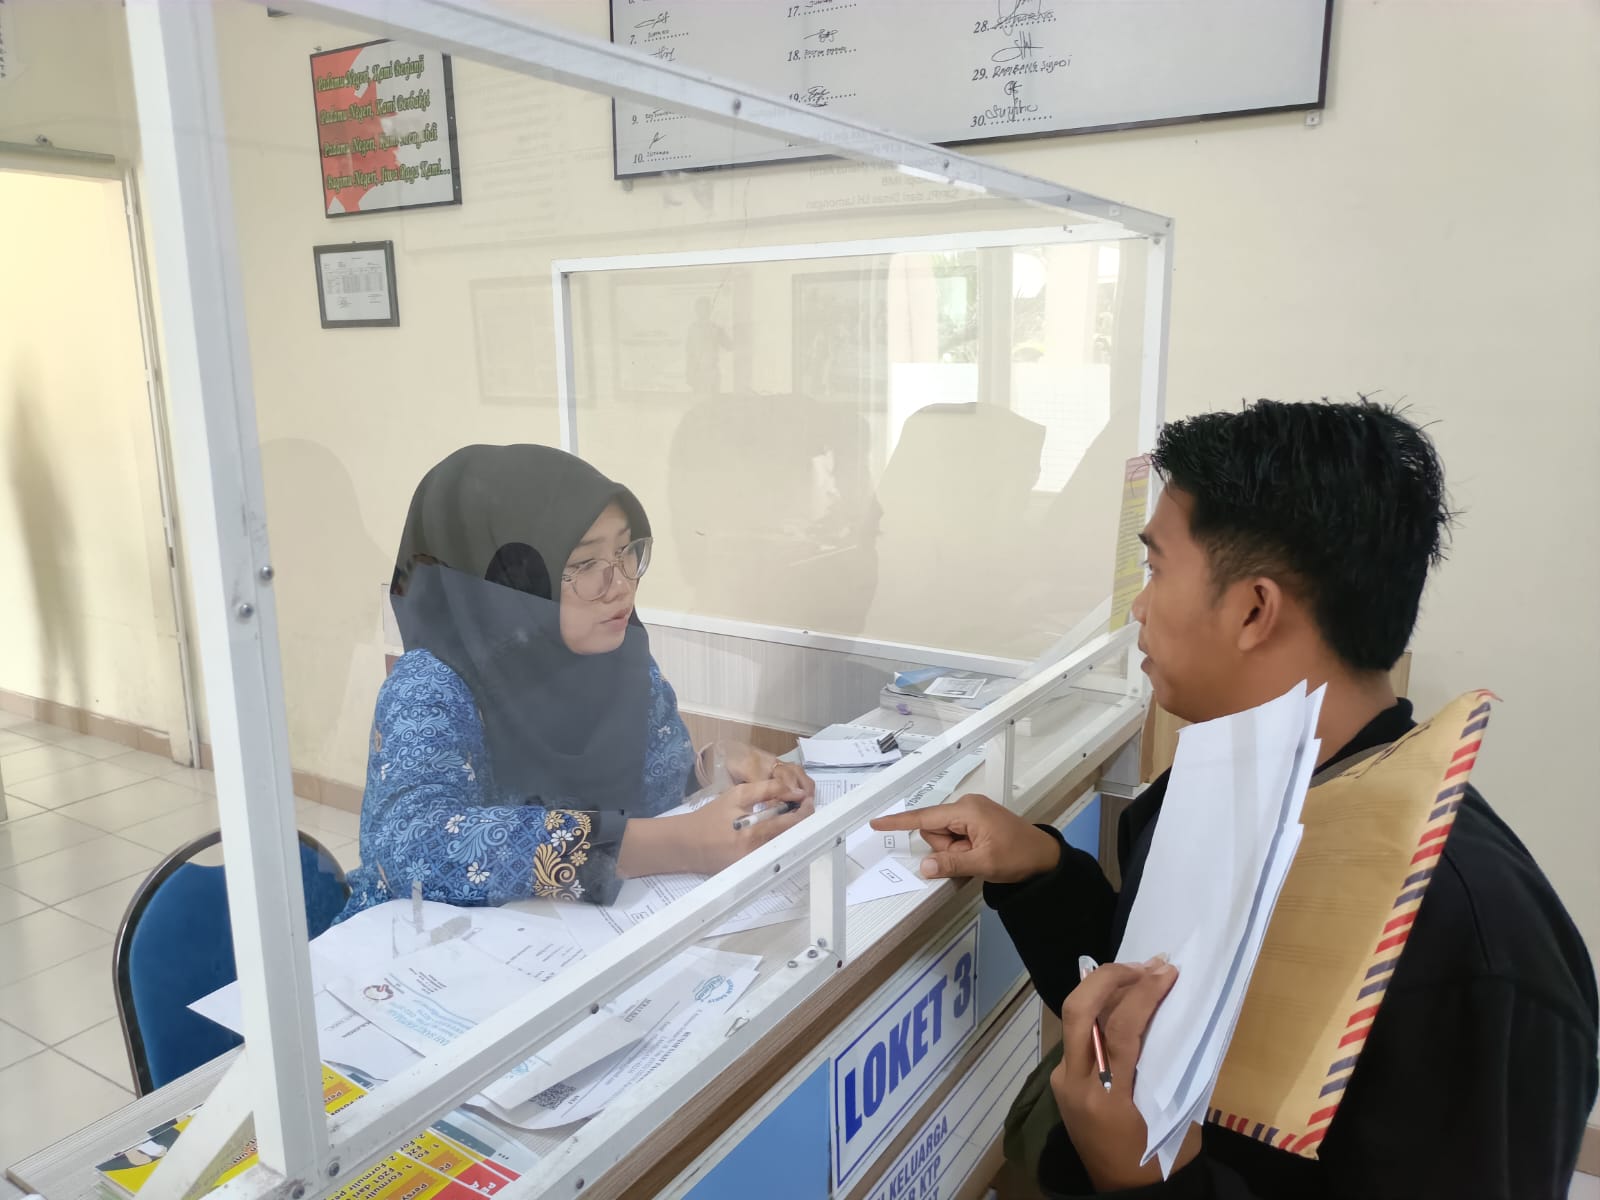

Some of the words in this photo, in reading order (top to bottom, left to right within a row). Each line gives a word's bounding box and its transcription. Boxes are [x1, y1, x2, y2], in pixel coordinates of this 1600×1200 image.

[788, 6, 800, 17] 17.
[973, 20, 990, 34] 28.
[630, 34, 637, 45] 7.
[787, 49, 801, 62] 18.
[972, 68, 988, 81] 29.
[970, 115, 987, 127] 30.
[632, 153, 645, 164] 10.
[844, 974, 948, 1144] LOKET
[953, 951, 972, 1019] 3
[889, 1115, 948, 1199] KELUARGA
[349, 1162, 388, 1191] Formulir
[373, 1167, 395, 1184] F201
[920, 1155, 941, 1198] KTP
[365, 1171, 404, 1200] Formulir
